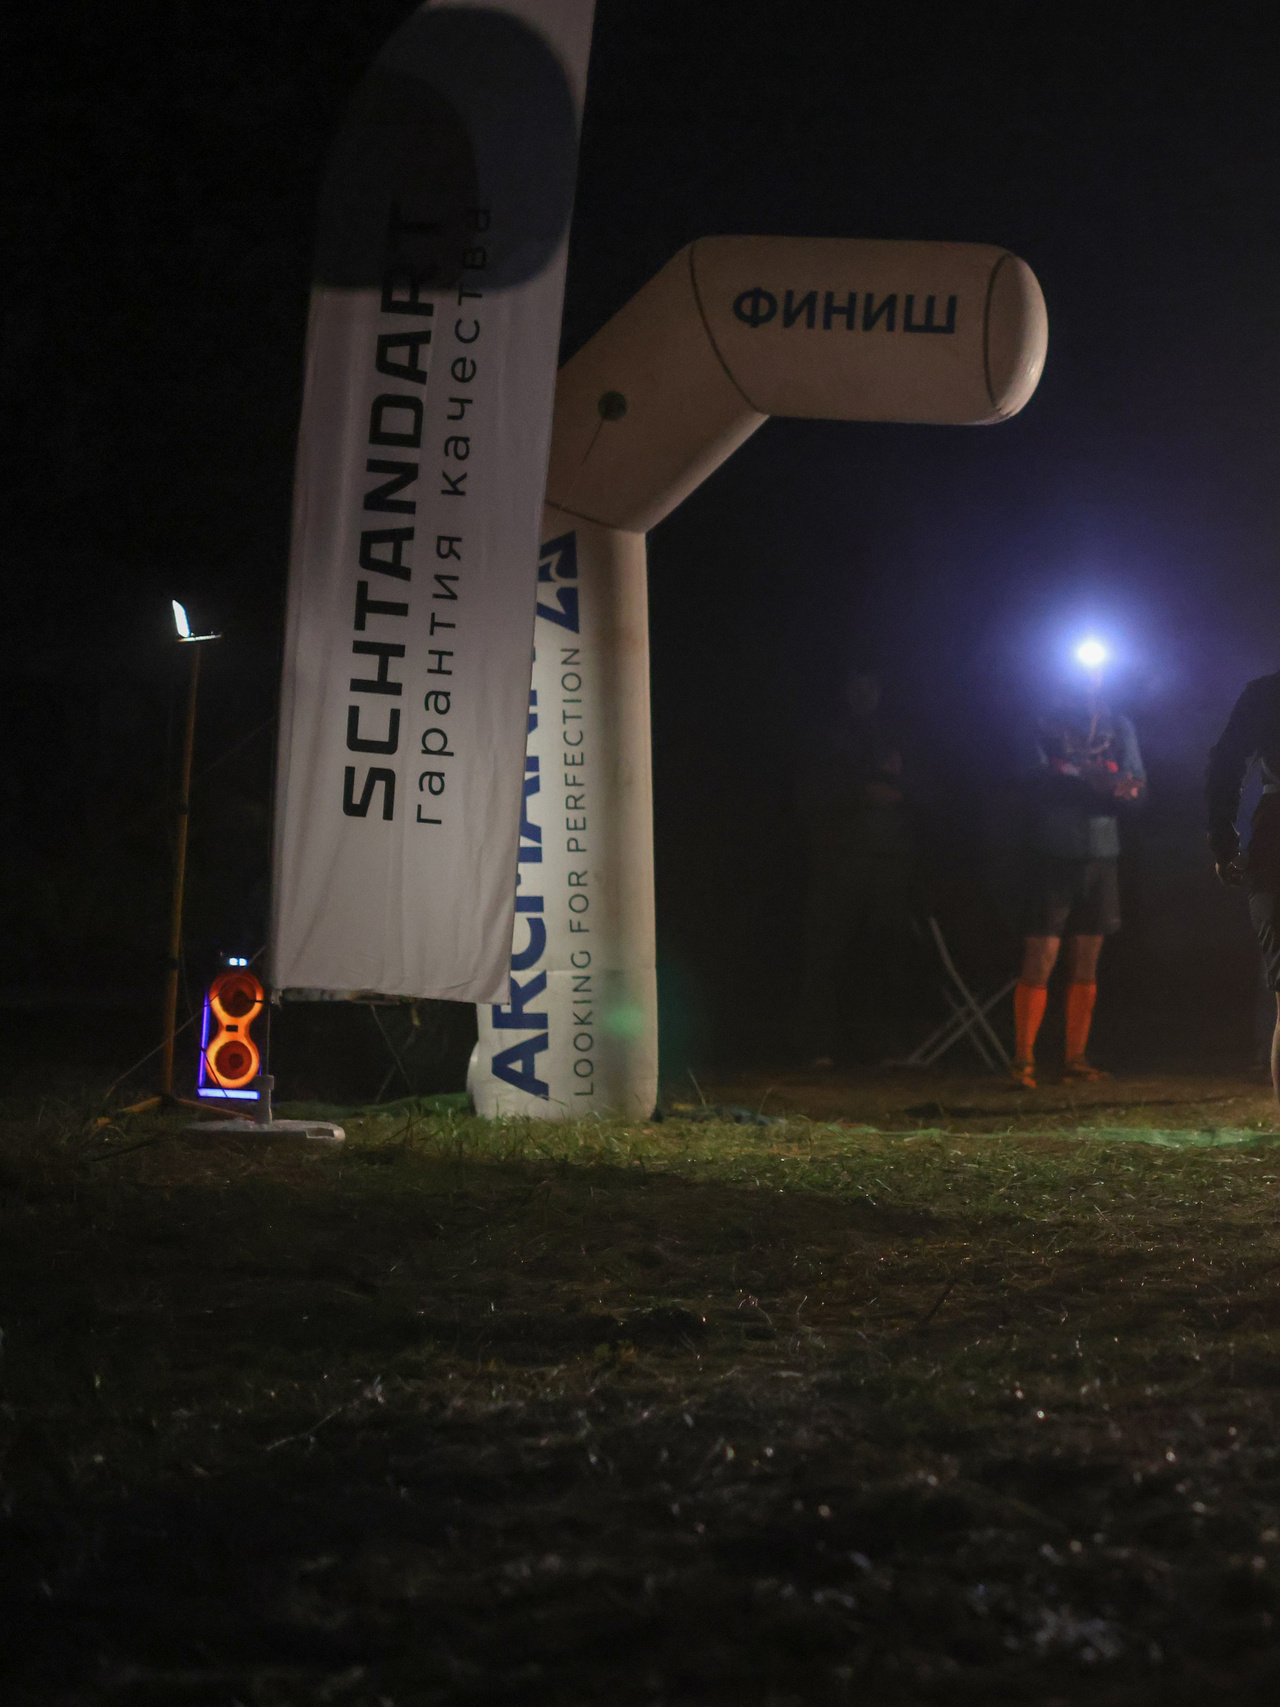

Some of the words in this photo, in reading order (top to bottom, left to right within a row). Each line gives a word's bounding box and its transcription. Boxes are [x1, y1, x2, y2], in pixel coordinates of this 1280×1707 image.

[732, 286, 958, 334] ФИНИШ
[342, 200, 441, 822] SCHTANDART
[416, 534, 463, 825] гарантия
[440, 208, 491, 497] качества
[561, 646, 588, 853] PERFECTION
[568, 870, 590, 933] FOR
[570, 948, 594, 1097] LOOKING
